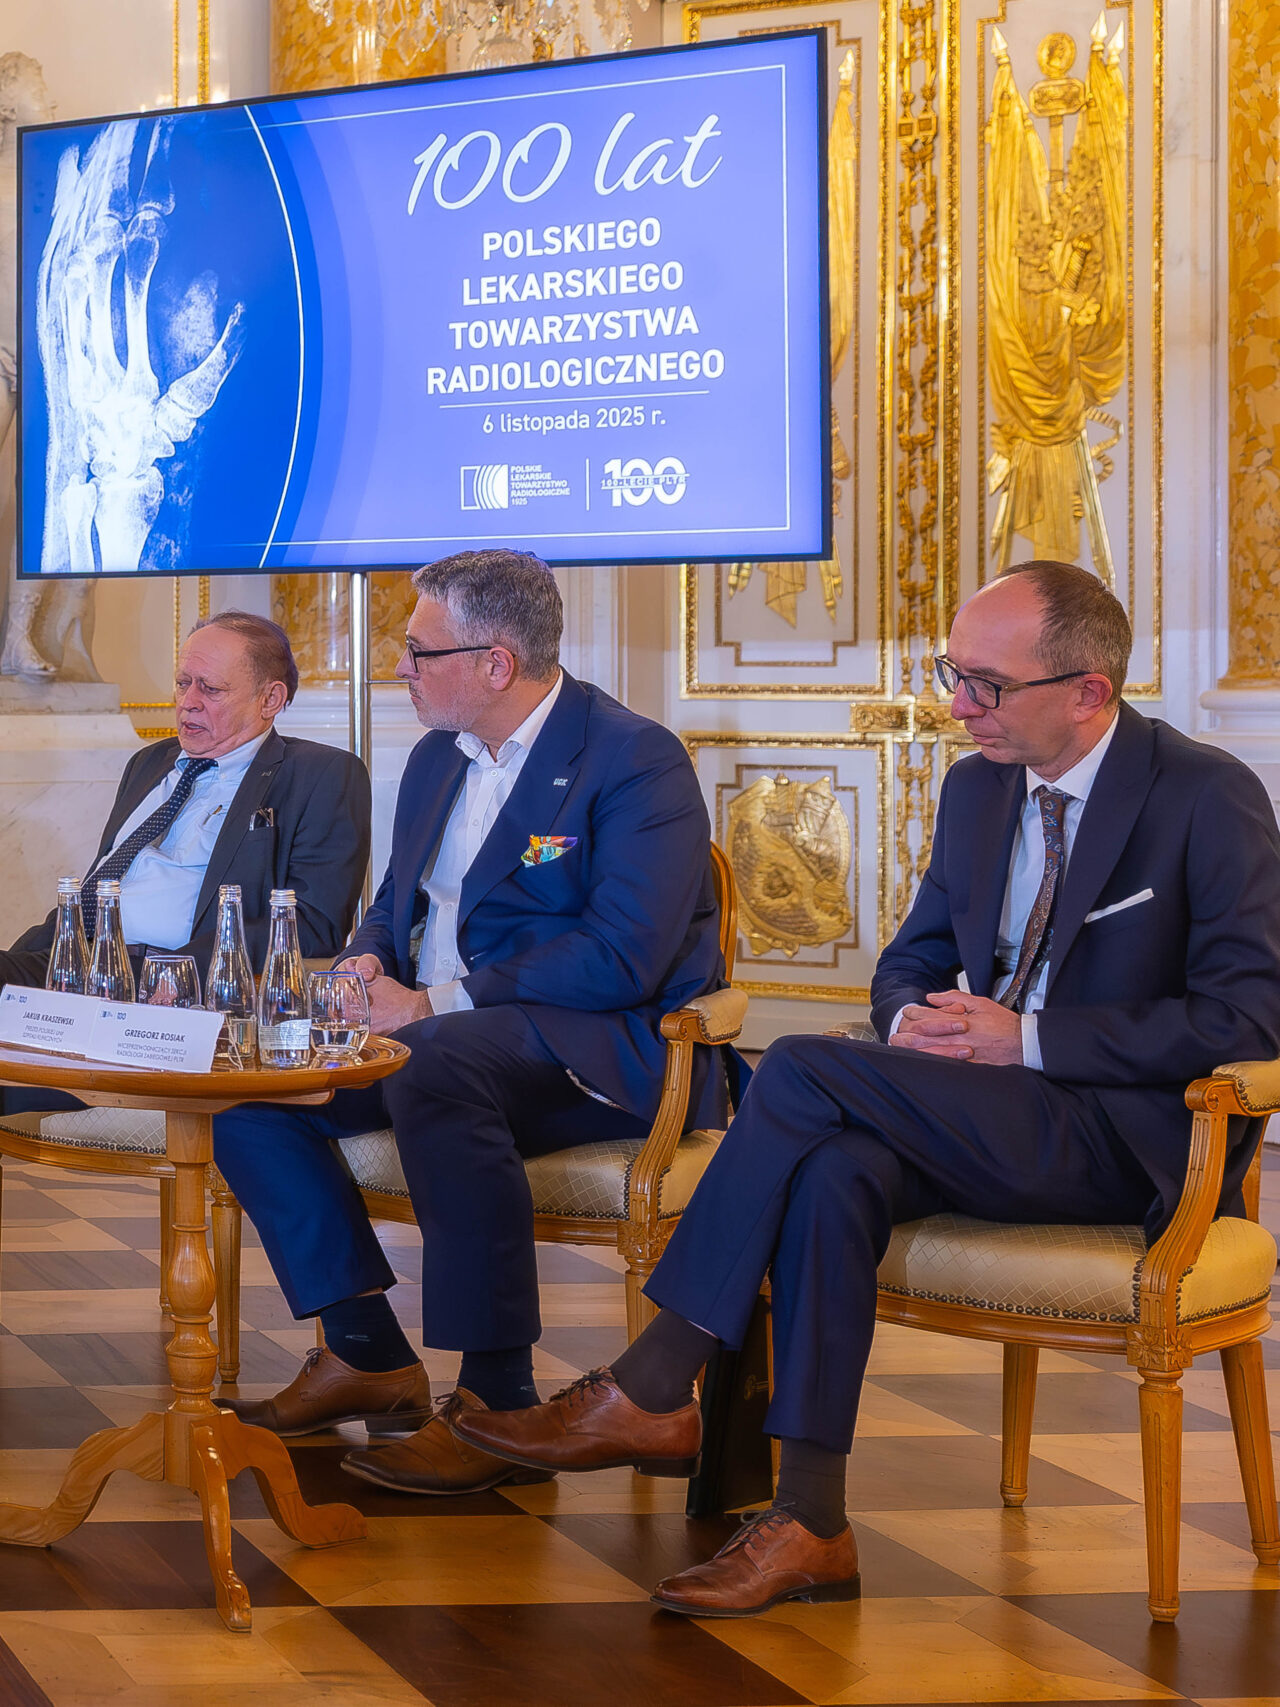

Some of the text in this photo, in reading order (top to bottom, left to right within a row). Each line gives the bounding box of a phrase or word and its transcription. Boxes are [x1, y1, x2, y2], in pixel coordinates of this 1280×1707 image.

[407, 111, 724, 216] 100 lat
[482, 217, 662, 260] POLSKIEGO
[462, 260, 684, 306] LEKARSKIEGO
[449, 305, 700, 350] TOWARZYSTWA
[426, 349, 726, 395] RADIOLOGICZNEGO
[482, 406, 666, 436] 6 listopada 2025 r.
[510, 464, 543, 473] POLSKIE
[510, 472, 552, 481] LEKARSKIE
[604, 456, 687, 507] 100
[510, 480, 568, 489] TOWARZYSTWO
[510, 488, 571, 497] RADIOLOGICZNE
[22, 1011, 75, 1026] JAKUB KRASZEWSKI
[124, 1029, 186, 1042] GRZEGORZ ROSIAK
